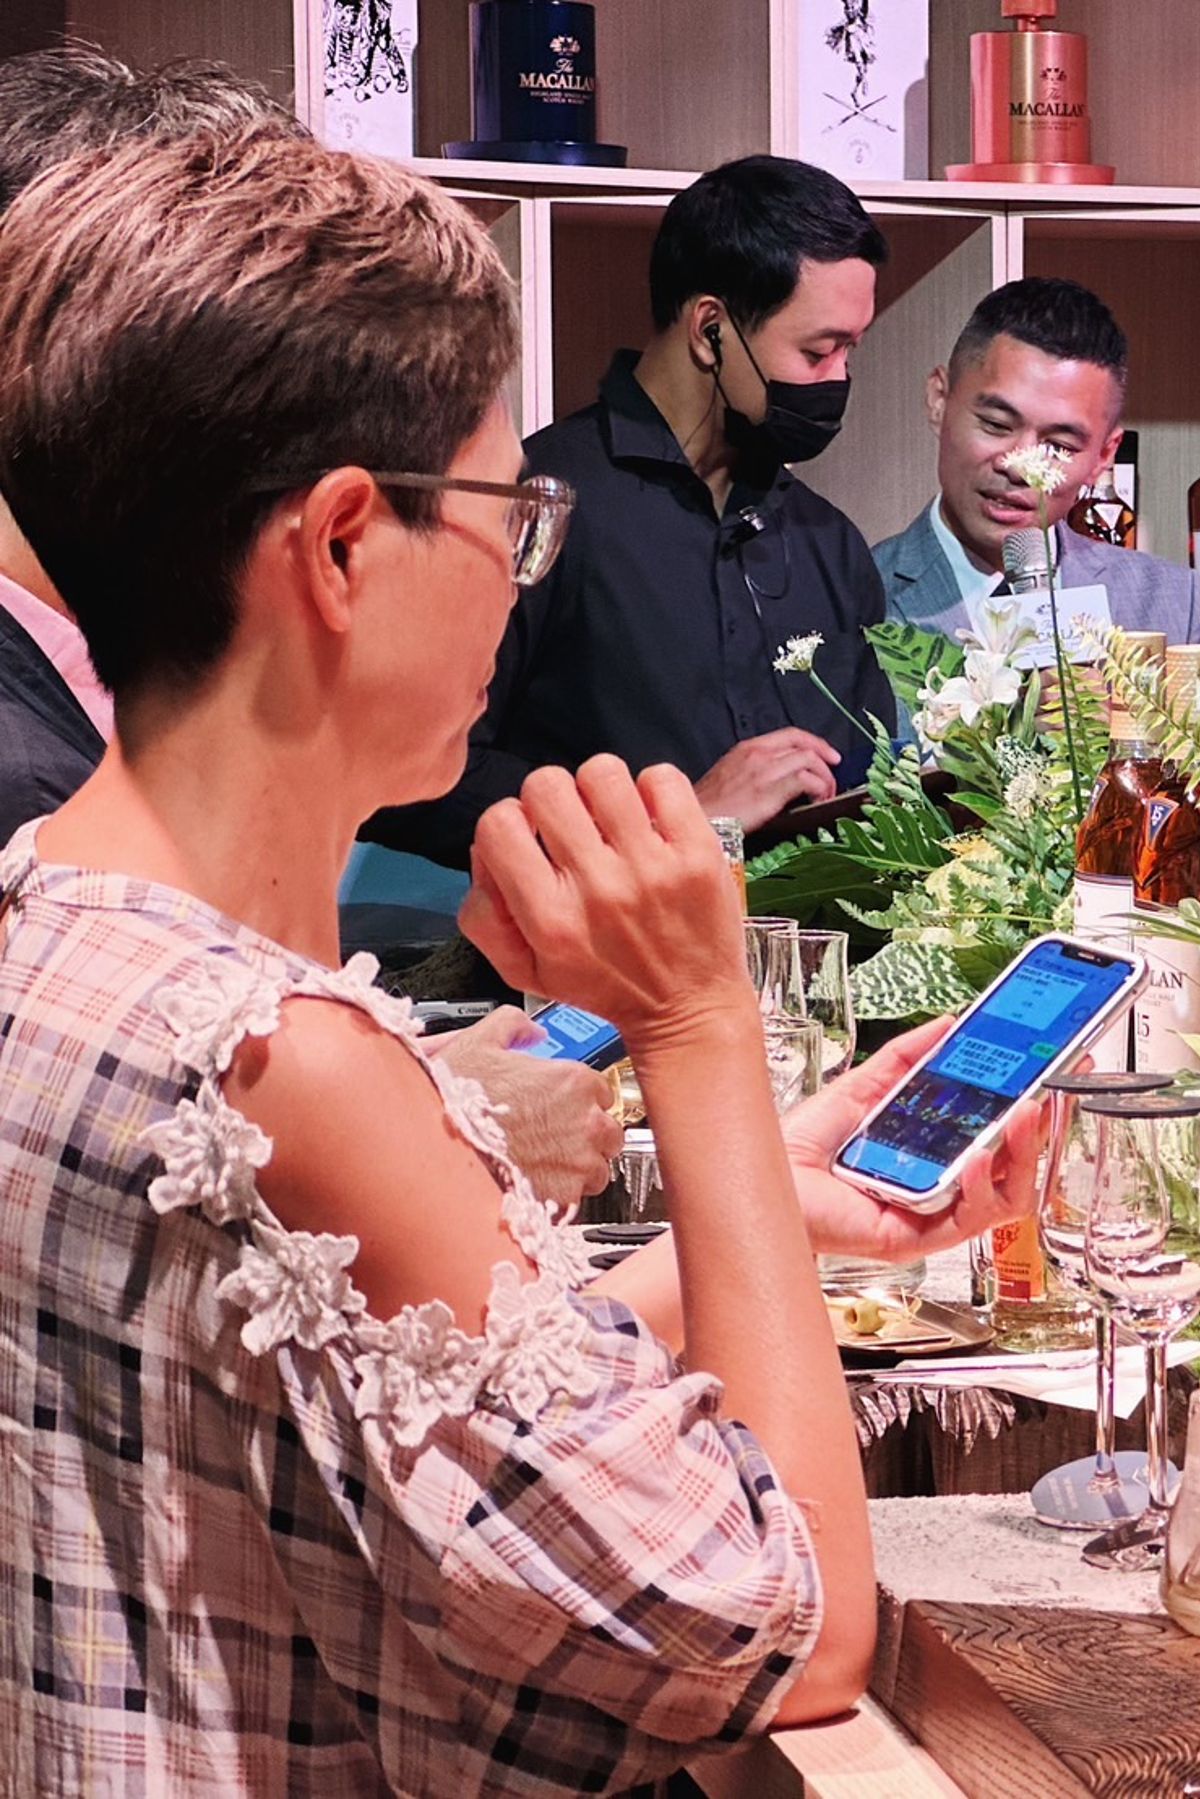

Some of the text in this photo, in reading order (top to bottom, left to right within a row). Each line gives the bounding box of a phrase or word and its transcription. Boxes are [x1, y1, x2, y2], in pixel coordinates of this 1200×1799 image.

[554, 58, 574, 73] The
[1009, 102, 1085, 117] MACALLAN
[458, 1007, 490, 1015] Canon
[1137, 1011, 1150, 1038] 15
